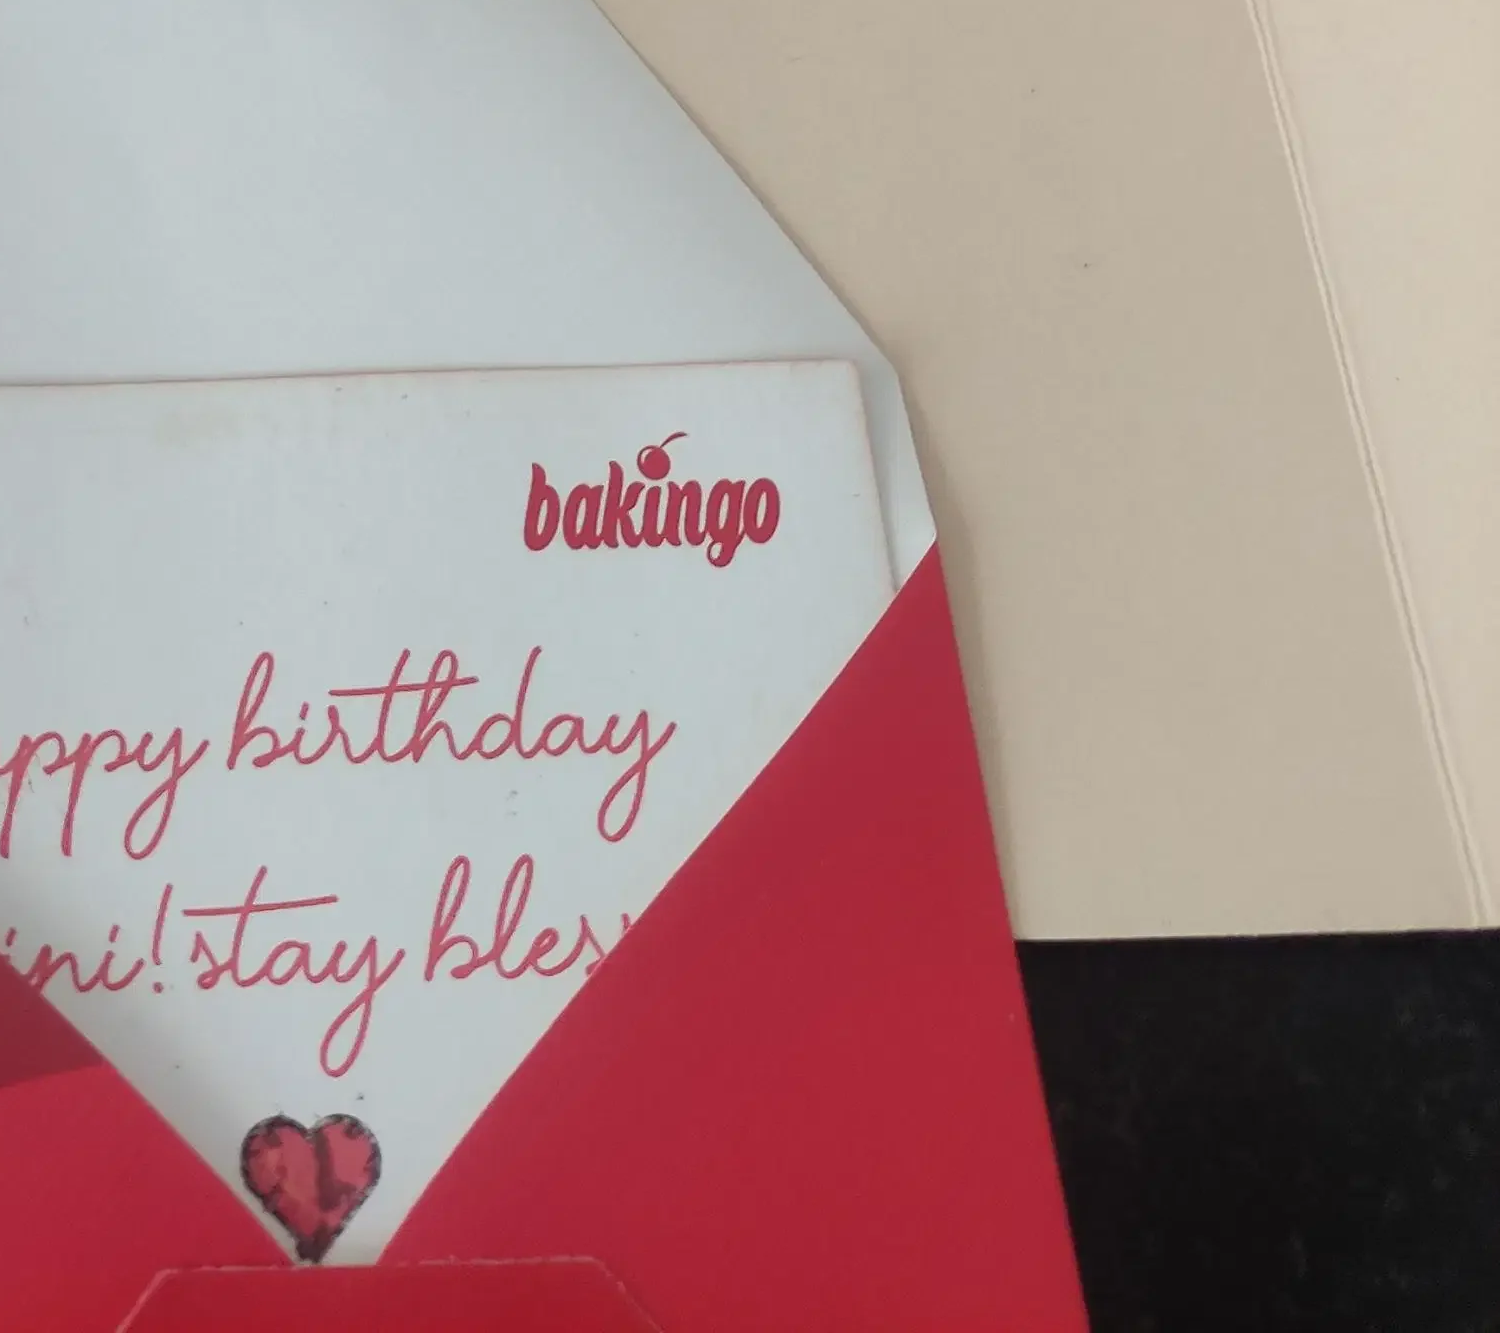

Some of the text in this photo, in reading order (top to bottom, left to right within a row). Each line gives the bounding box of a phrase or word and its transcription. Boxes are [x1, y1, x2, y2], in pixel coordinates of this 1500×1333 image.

[523, 445, 782, 568] bakingo
[226, 645, 678, 843] birthday
[423, 852, 632, 984] bles
